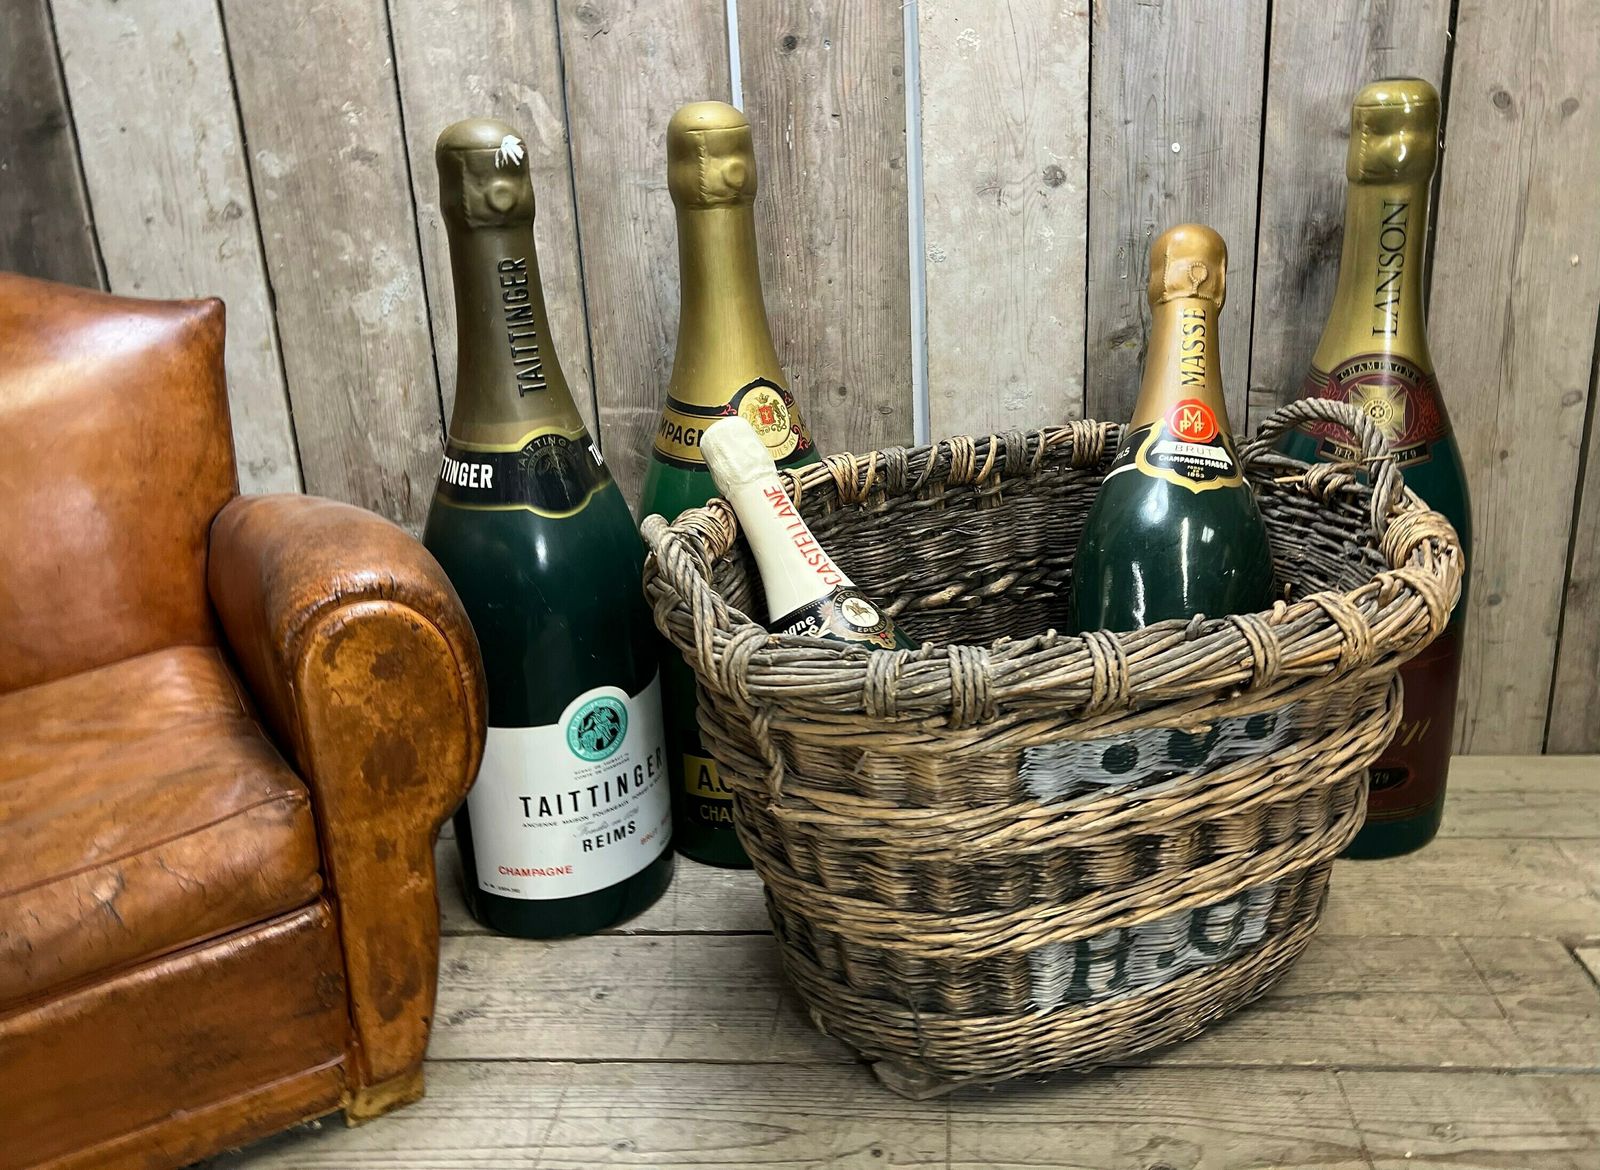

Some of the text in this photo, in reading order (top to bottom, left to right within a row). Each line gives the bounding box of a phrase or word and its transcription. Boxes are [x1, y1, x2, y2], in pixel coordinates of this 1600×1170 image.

[1372, 200, 1410, 337] LANSON
[498, 256, 548, 398] TAITTINGER
[1158, 454, 1204, 466] CHAMPAGNE
[1174, 444, 1213, 456] BRUT
[1392, 448, 1417, 462] 979
[440, 454, 493, 489] TINGER
[519, 746, 663, 818] TAITTINGER
[700, 804, 736, 823] CHA
[582, 820, 637, 853] REIMS
[498, 864, 575, 878] CHAMPAGNE
